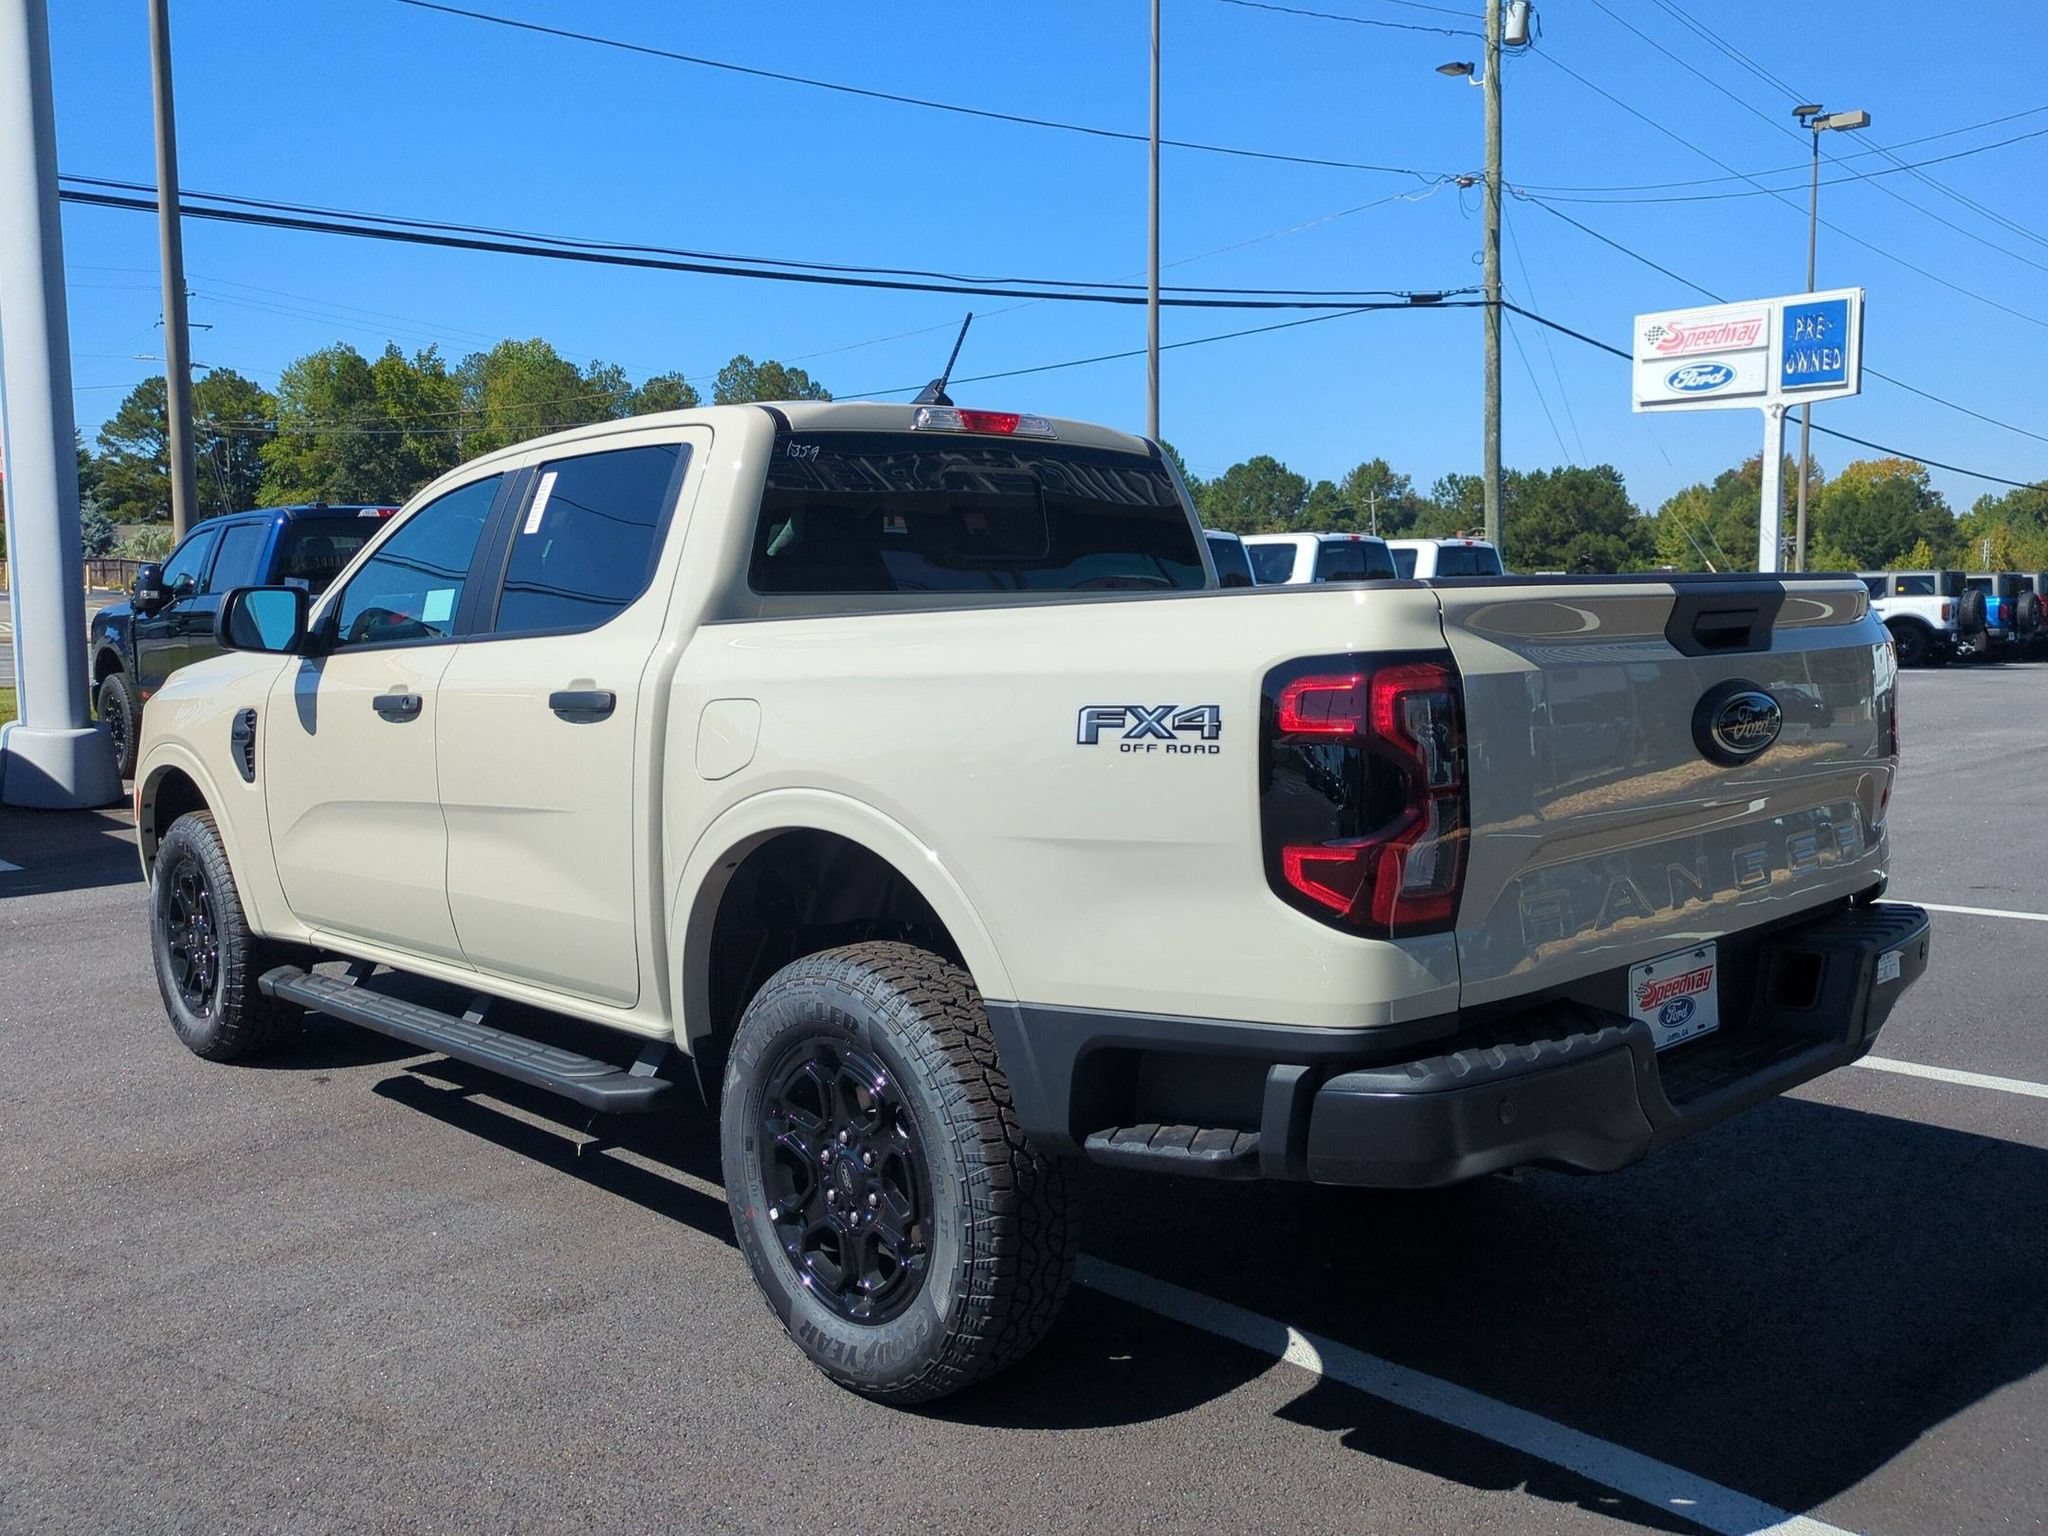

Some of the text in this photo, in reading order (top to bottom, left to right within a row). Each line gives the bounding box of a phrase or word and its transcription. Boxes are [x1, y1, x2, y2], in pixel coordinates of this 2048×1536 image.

[1656, 319, 1763, 352] Speedway
[1786, 348, 1841, 374] OWNED
[1674, 367, 1726, 388] Ford
[786, 440, 820, 462] 1359
[1076, 705, 1222, 745] FX4
[1725, 705, 1773, 740] Ford
[1119, 743, 1221, 754] OFF ROAD
[1518, 818, 1866, 947] RANGER
[1639, 967, 1714, 1009] Speedway
[1664, 1000, 1692, 1023] Ford
